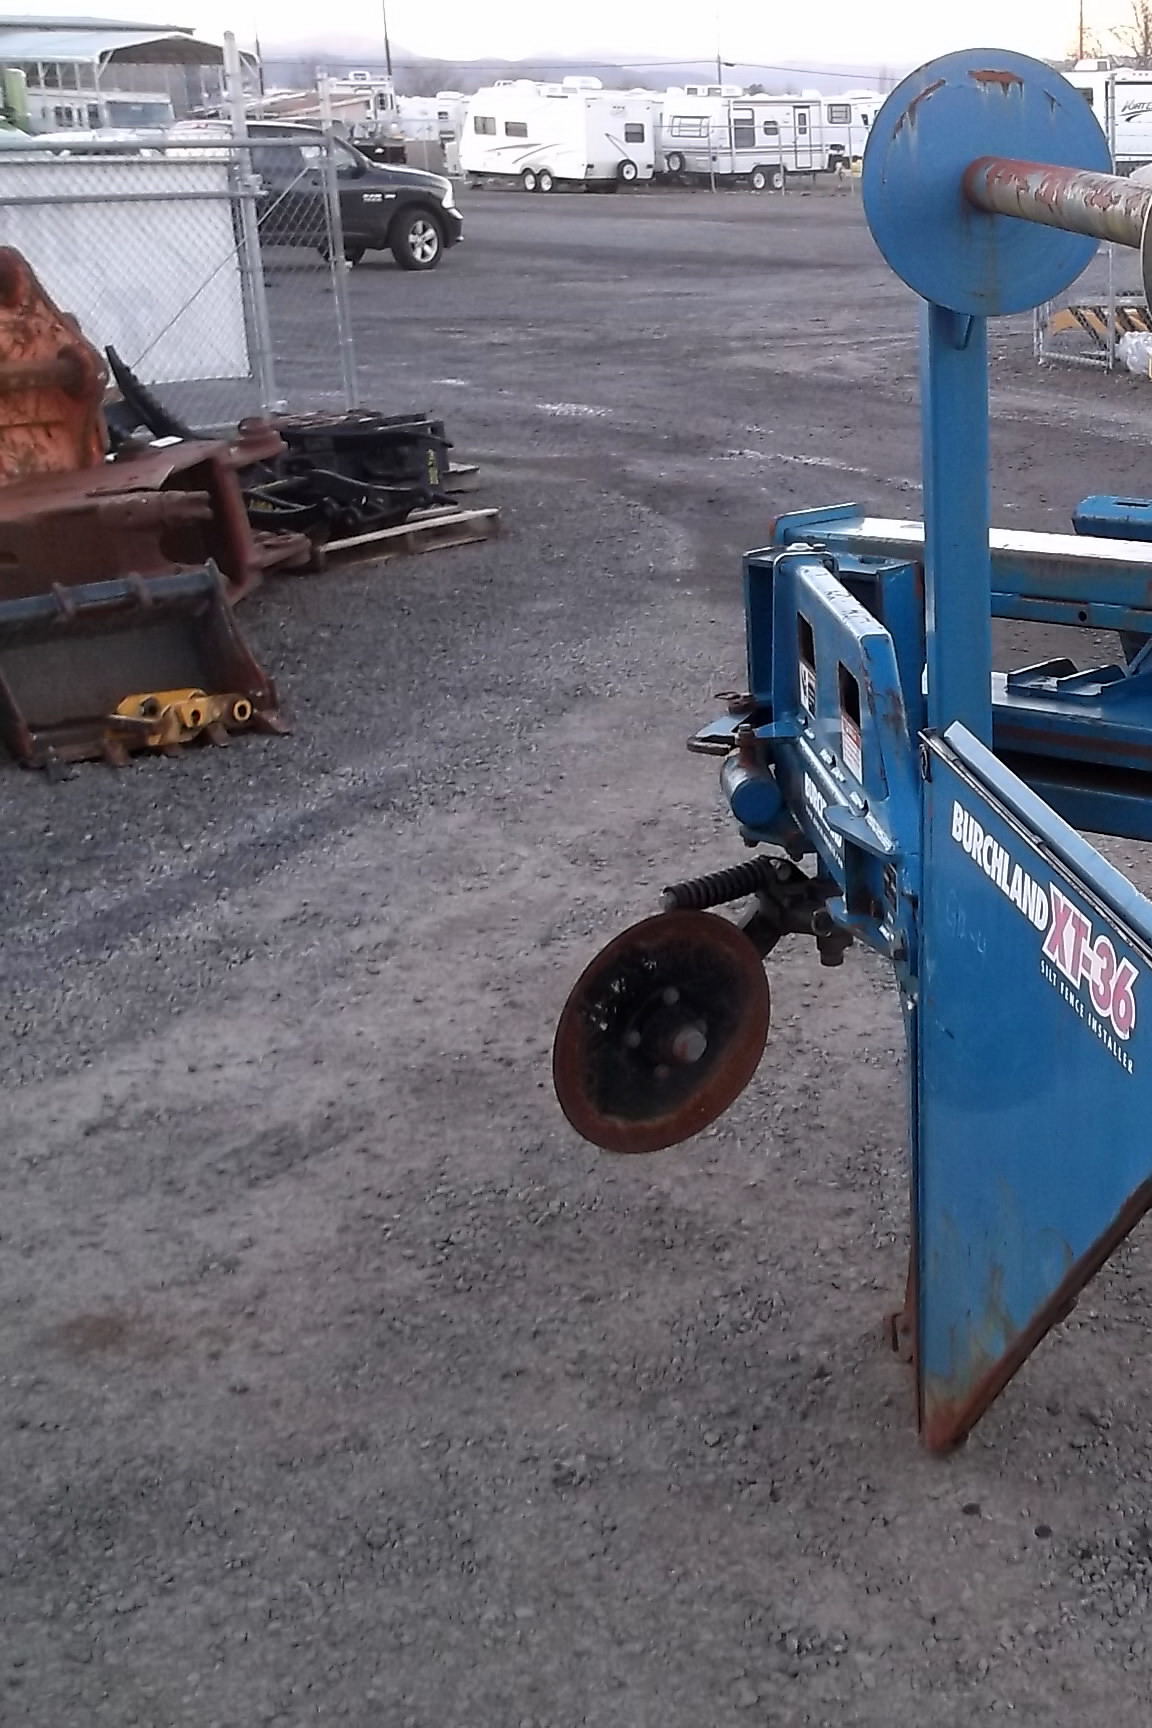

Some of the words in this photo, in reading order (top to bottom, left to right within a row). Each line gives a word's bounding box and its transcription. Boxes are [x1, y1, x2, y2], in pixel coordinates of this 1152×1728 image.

[952, 800, 1048, 931] BURCHLAND
[1042, 881, 1139, 1040] XT-36
[1040, 959, 1057, 987] SILT
[1060, 981, 1084, 1018] FENCE
[1088, 1012, 1133, 1075] INSTALLER
